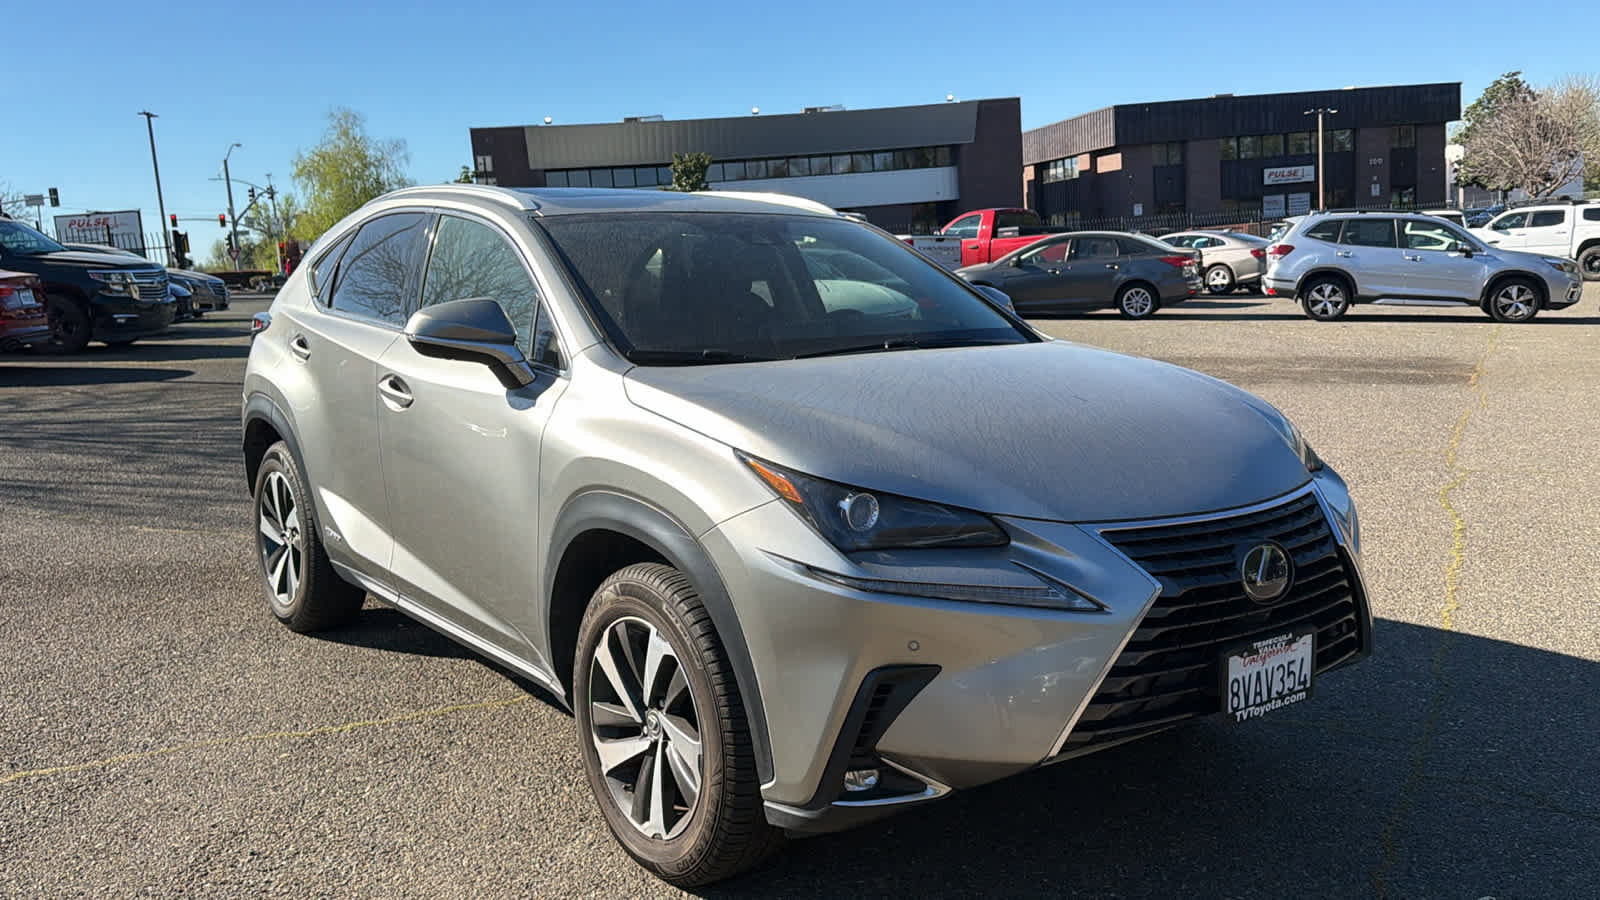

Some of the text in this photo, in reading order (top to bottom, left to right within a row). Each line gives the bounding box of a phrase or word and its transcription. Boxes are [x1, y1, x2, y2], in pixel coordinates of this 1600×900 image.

[1268, 168, 1299, 178] PULSE
[68, 217, 109, 228] PULSE
[1230, 656, 1308, 713] 8VAV354
[1235, 690, 1307, 722] TVToyota.com
